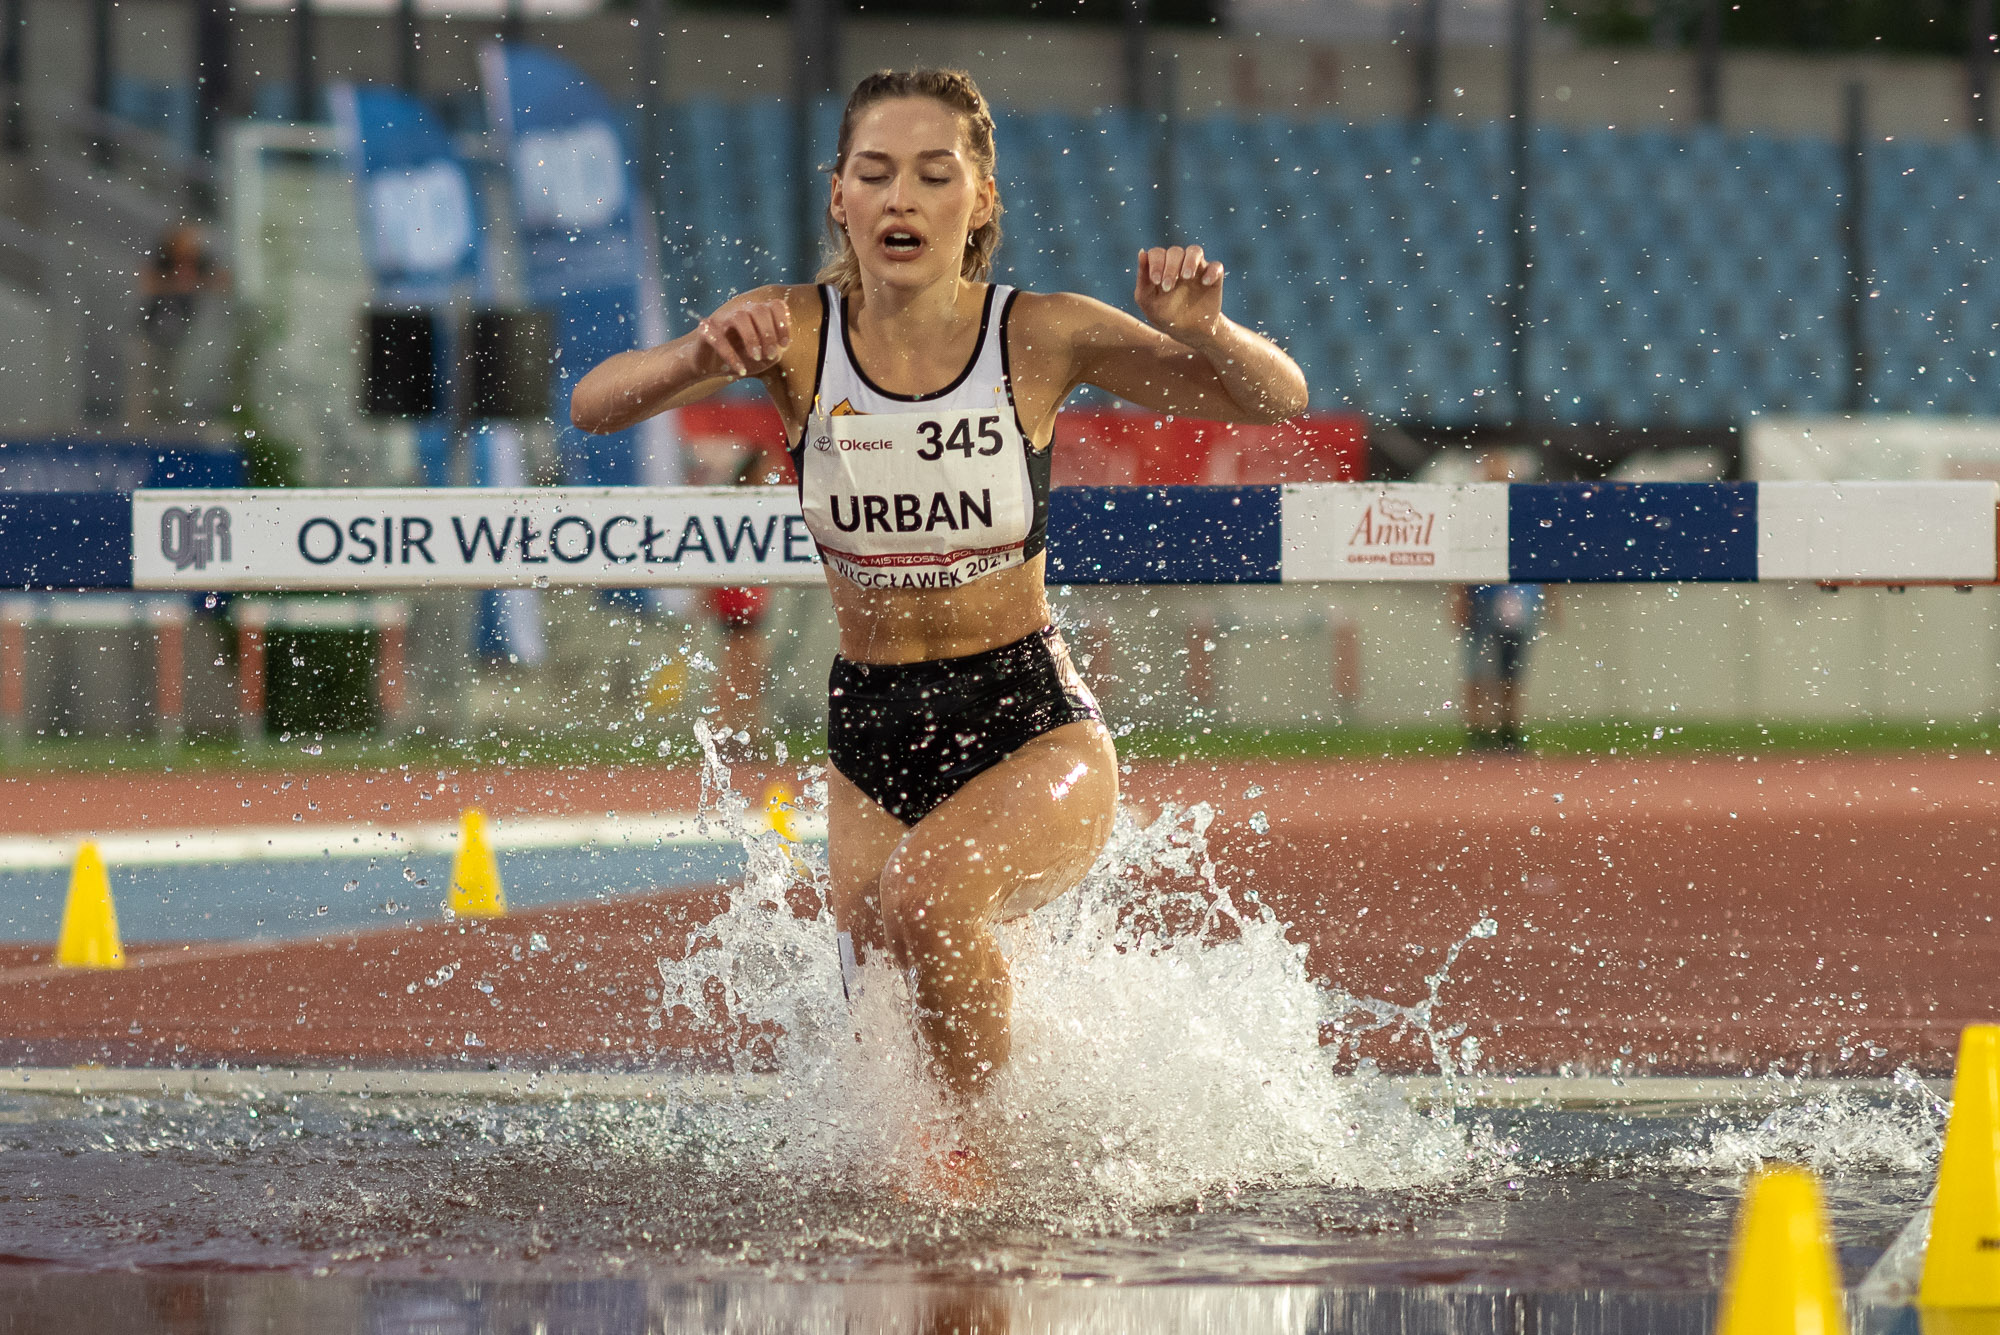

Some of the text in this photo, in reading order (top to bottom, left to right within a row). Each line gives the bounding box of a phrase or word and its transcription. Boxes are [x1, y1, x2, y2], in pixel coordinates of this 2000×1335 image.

[916, 415, 1004, 462] 345
[830, 488, 993, 533] URBAN
[1348, 504, 1435, 546] Anwil
[299, 514, 818, 564] OSIR WŁOCŁAWE
[952, 547, 993, 560] POLKI
[835, 551, 1011, 588] WŁOCŁAWEK 2021
